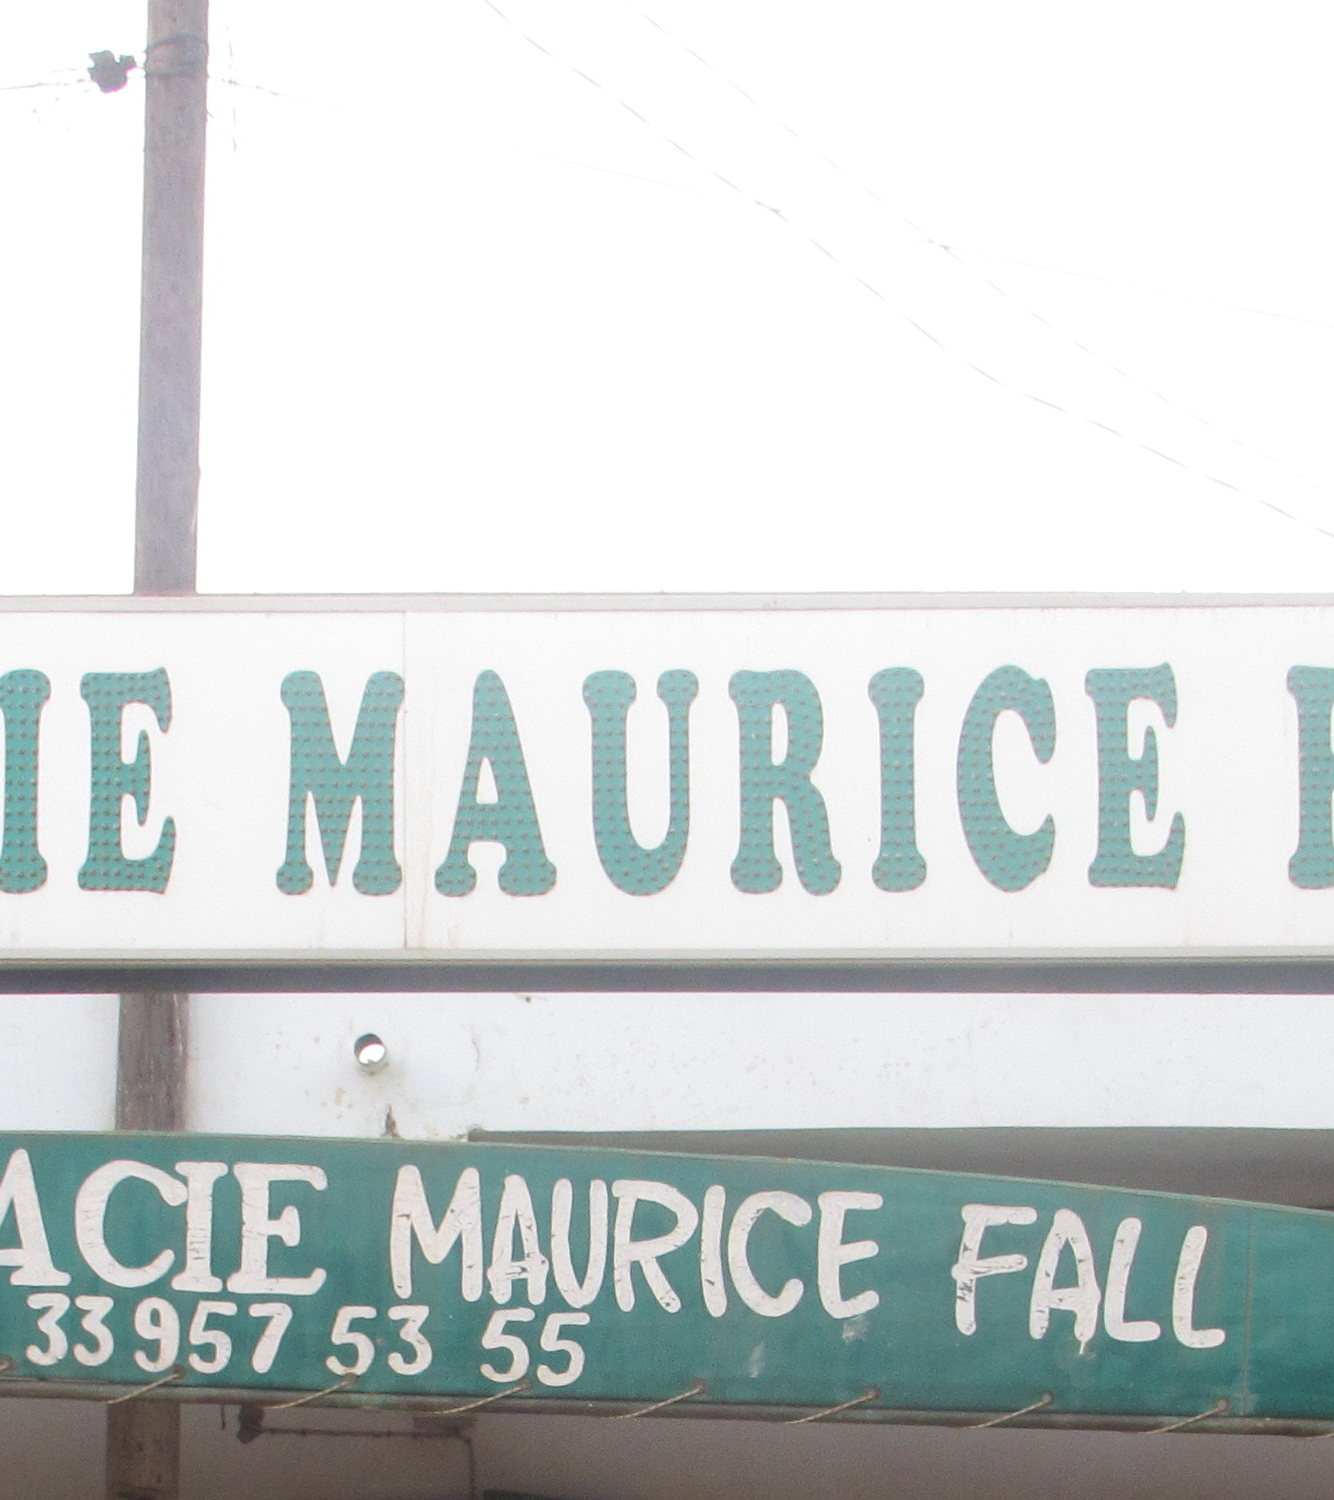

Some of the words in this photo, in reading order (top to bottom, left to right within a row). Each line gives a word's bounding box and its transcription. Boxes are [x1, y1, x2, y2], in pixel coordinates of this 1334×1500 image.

[275, 665, 1186, 897] MAURICE
[25, 1292, 115, 1367] 33
[134, 1296, 292, 1374] 957
[326, 1304, 433, 1376] 53
[480, 1306, 591, 1387] 55
[389, 1164, 884, 1320] MAURICE
[951, 1203, 1226, 1356] FALL
